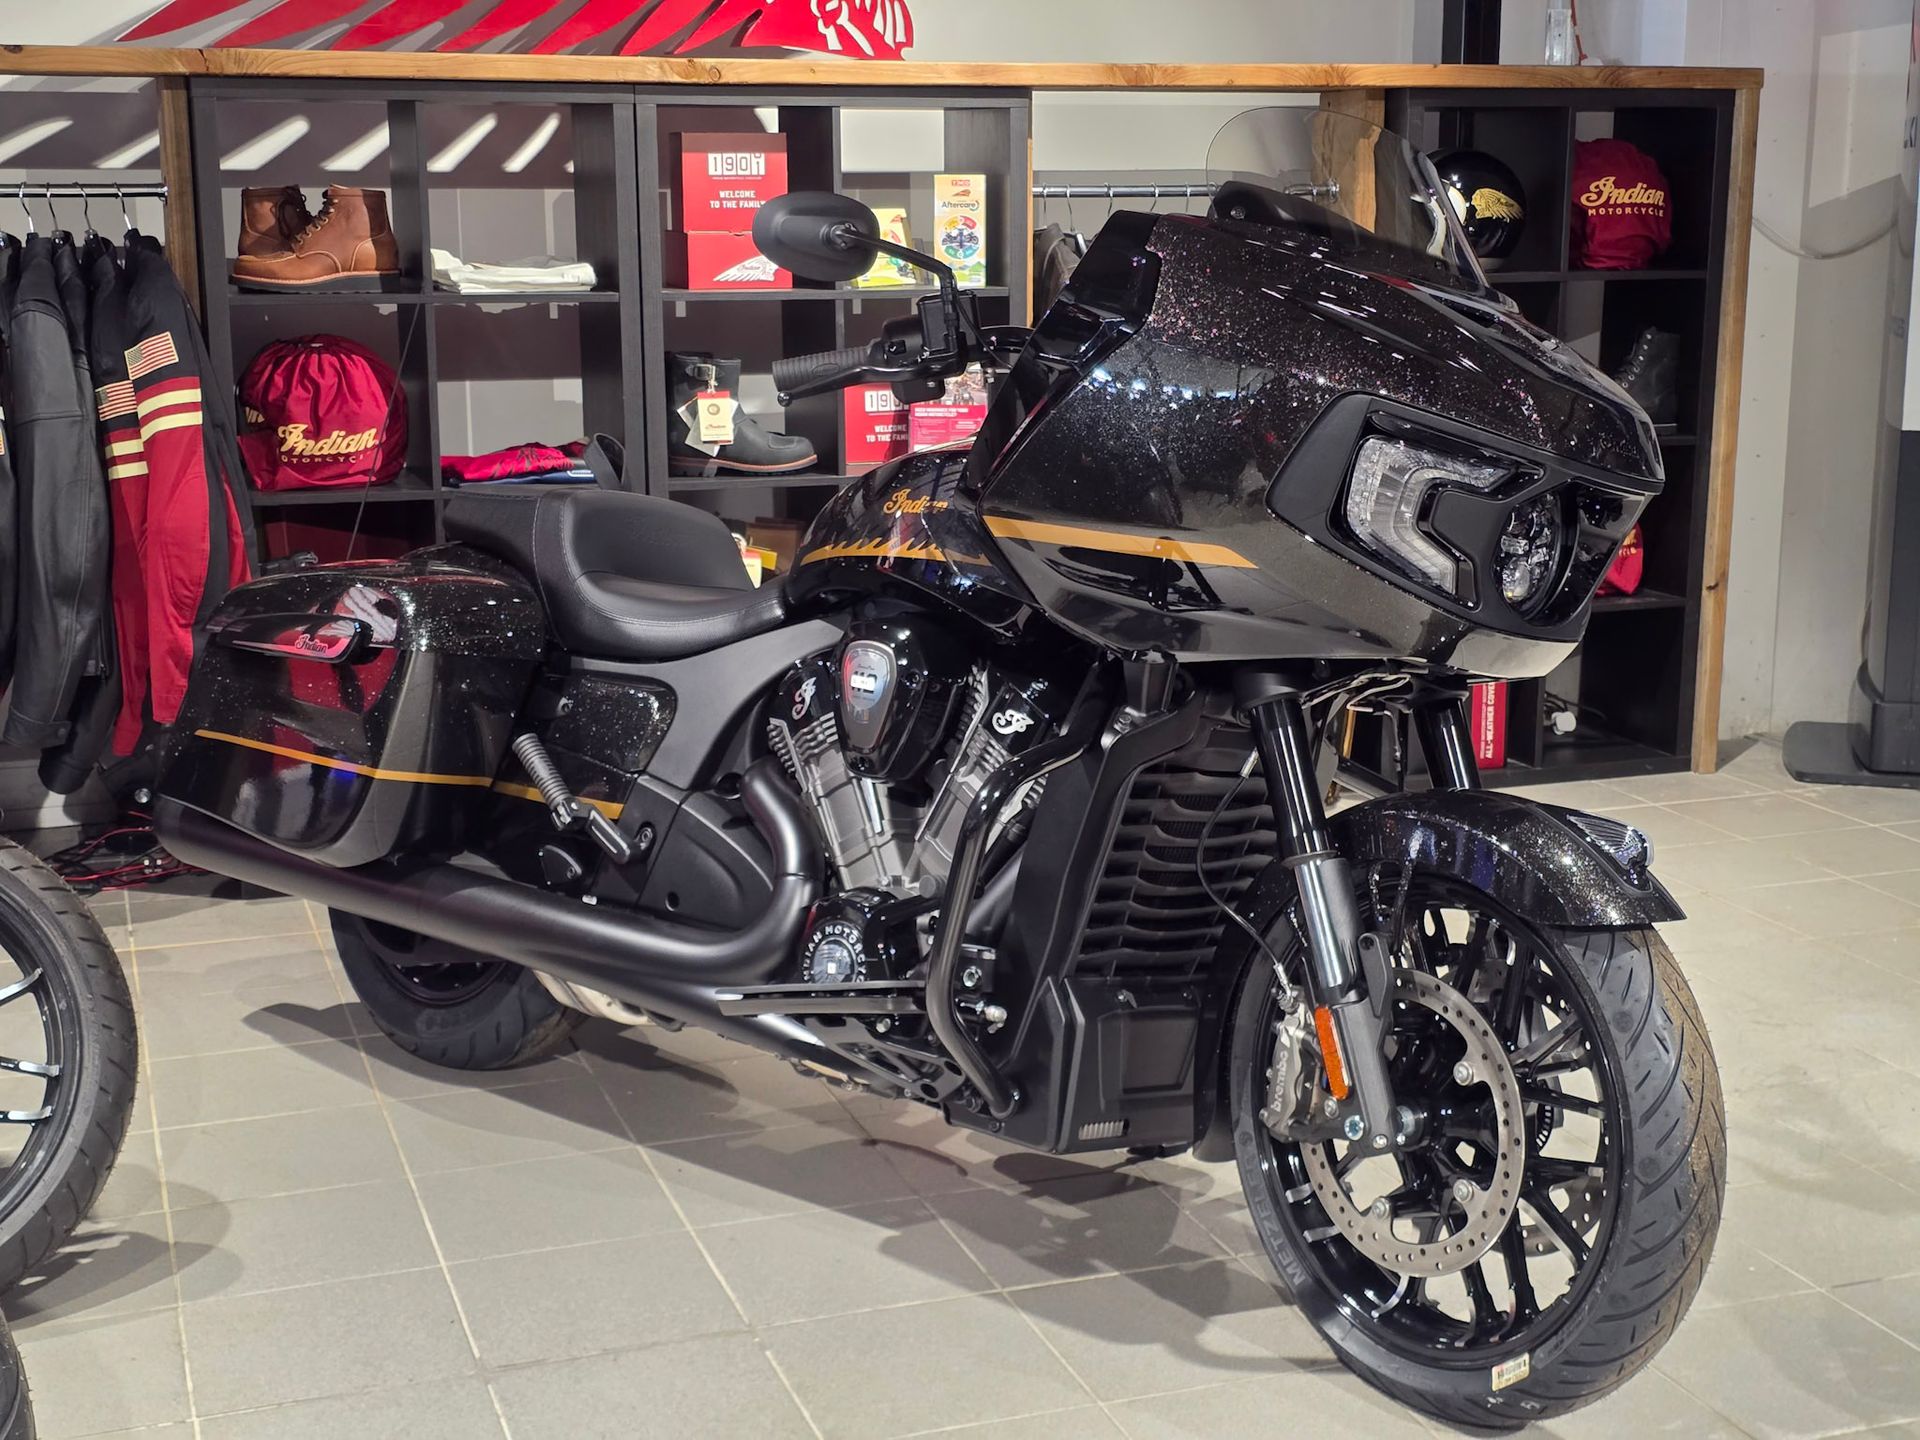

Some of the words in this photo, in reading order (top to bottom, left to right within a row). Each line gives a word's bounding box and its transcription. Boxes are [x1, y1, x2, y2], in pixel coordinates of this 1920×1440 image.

[710, 154, 765, 176] 1901
[719, 190, 756, 198] WELCOME
[1580, 176, 1665, 207] Indian
[710, 200, 720, 208] TO
[722, 200, 737, 208] THE
[942, 201, 976, 209] Aftercare
[1588, 206, 1664, 217] MOTORCYCLE
[866, 435, 876, 443] TO
[877, 433, 891, 442] THE
[892, 433, 908, 441] FAMI
[874, 424, 907, 433] WELCOME
[278, 423, 379, 456] Indian
[281, 451, 370, 464] OTORCYC
[883, 488, 949, 514] Indian
[295, 633, 329, 654] Indian
[1487, 682, 1496, 705] COVE
[1485, 705, 1495, 759] ALL-WEATHER
[803, 931, 823, 981] NDIAN
[825, 925, 867, 983] MOTORCYC
[1270, 1050, 1289, 1113] brembo
